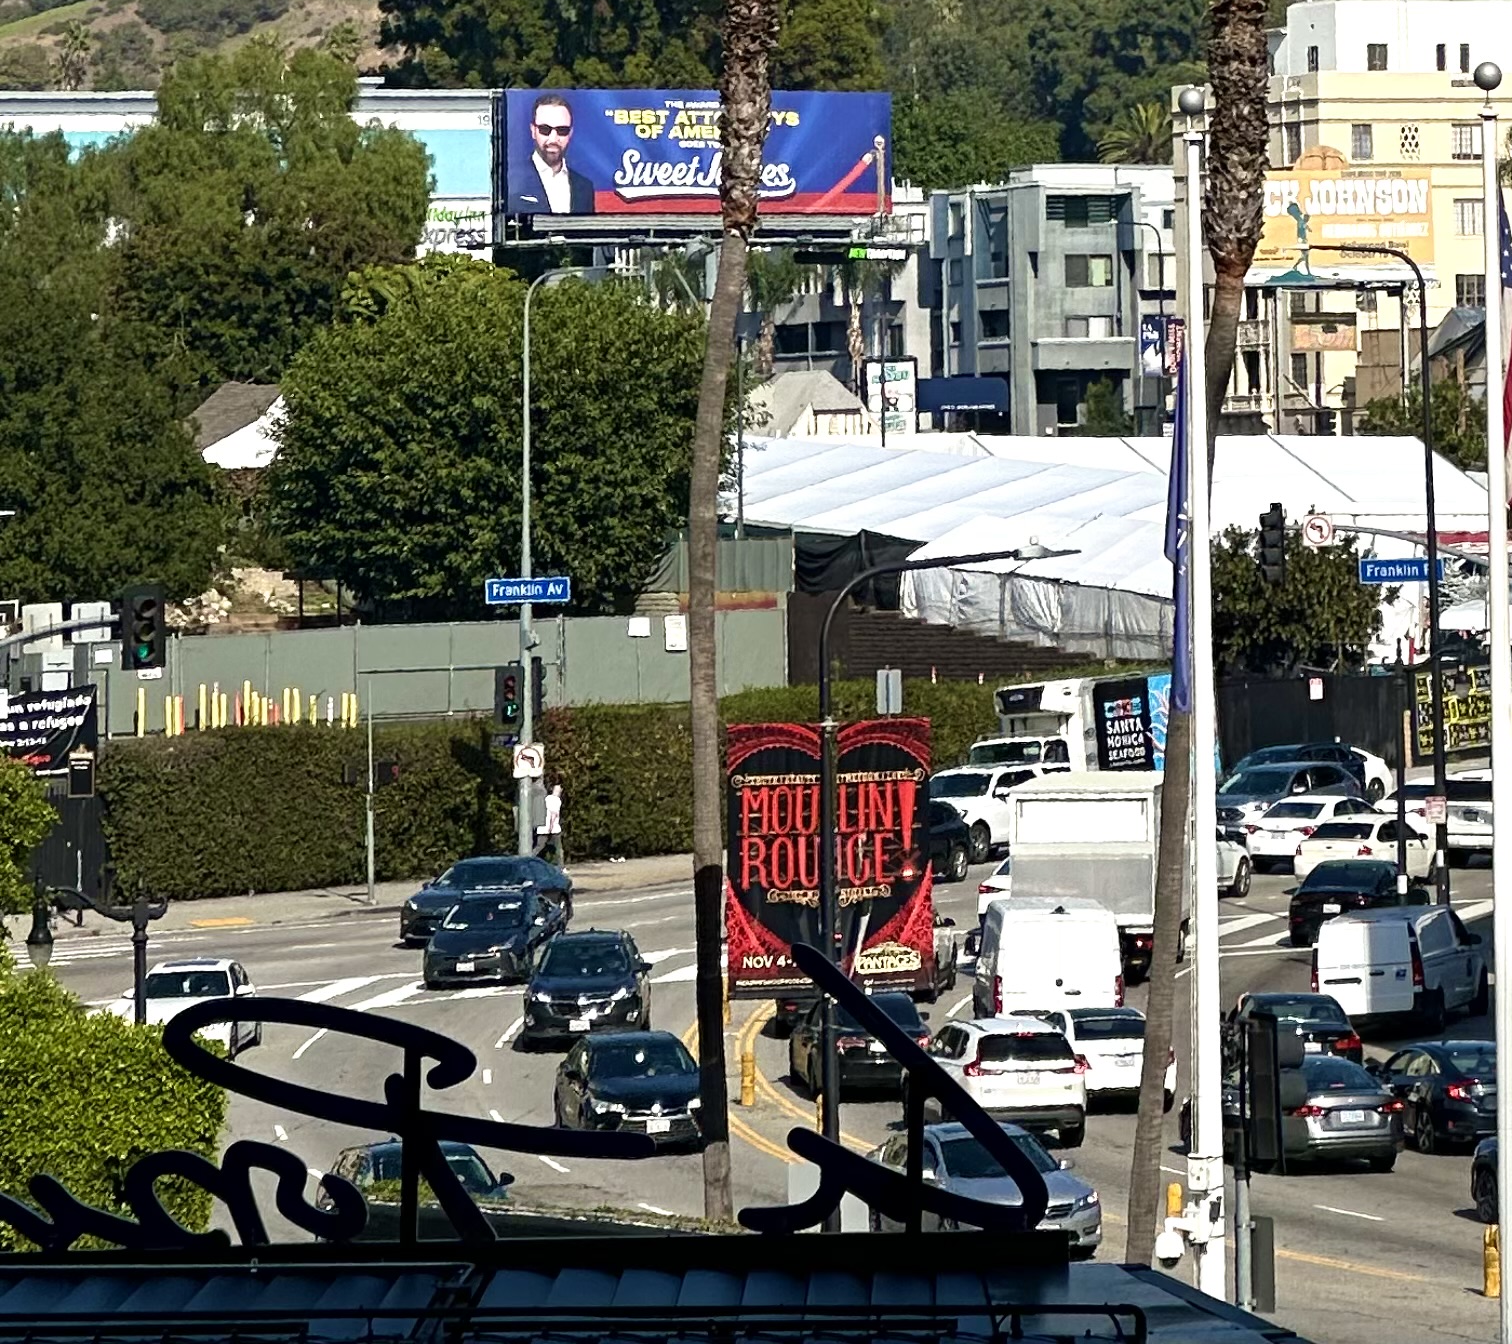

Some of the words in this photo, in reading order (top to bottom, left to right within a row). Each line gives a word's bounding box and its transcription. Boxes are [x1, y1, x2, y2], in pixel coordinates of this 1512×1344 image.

[675, 110, 800, 127] ATTYS
[635, 125, 664, 139] OF
[614, 148, 699, 186] Sweet
[1263, 179, 1299, 217] CK
[1304, 178, 1429, 216] JOHNSON
[1366, 564, 1419, 577] Franklin
[492, 583, 543, 597] Franklin
[546, 582, 564, 596] Av
[32, 715, 84, 731] refugee
[1106, 716, 1144, 735] SANTA
[1107, 732, 1145, 748] MONICA
[1108, 746, 1146, 761] SEAFOOD
[742, 955, 774, 969] NOV
